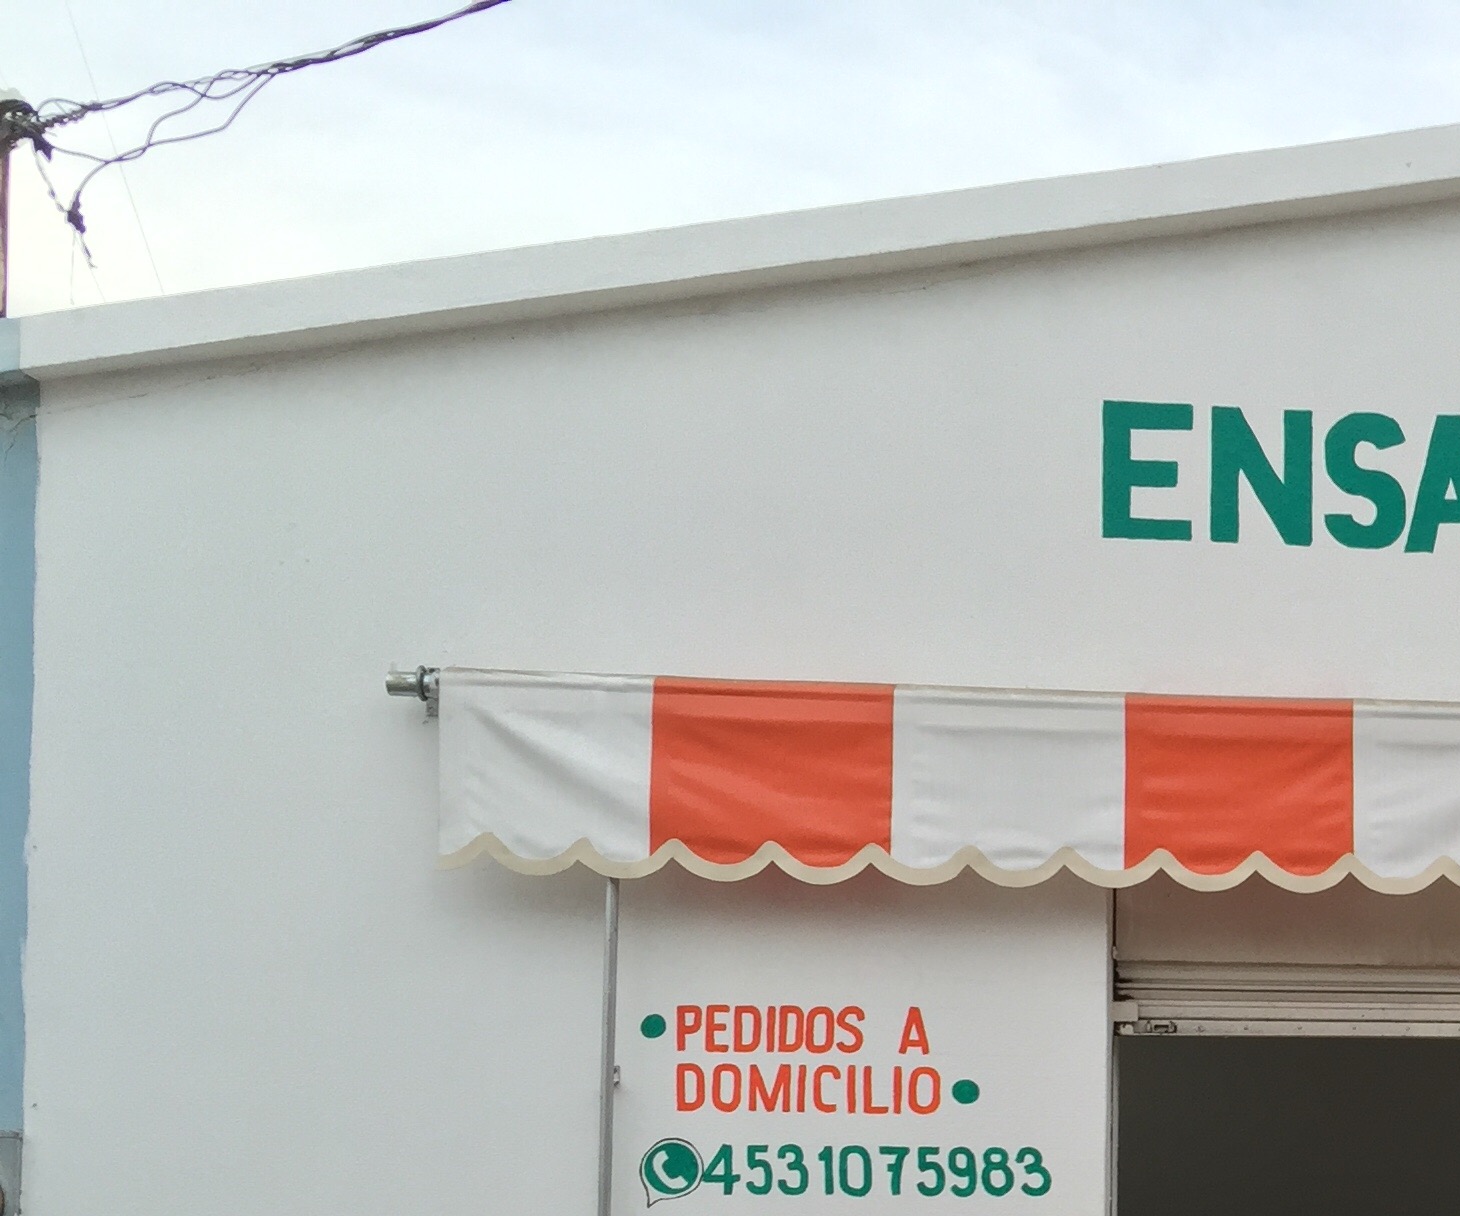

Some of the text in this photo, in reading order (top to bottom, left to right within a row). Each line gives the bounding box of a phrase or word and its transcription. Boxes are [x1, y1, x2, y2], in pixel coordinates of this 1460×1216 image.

[676, 1004, 930, 1056] PEDIDOS A
[675, 1062, 941, 1115] DOMICILIO
[700, 1144, 1052, 1198] 4531075983
